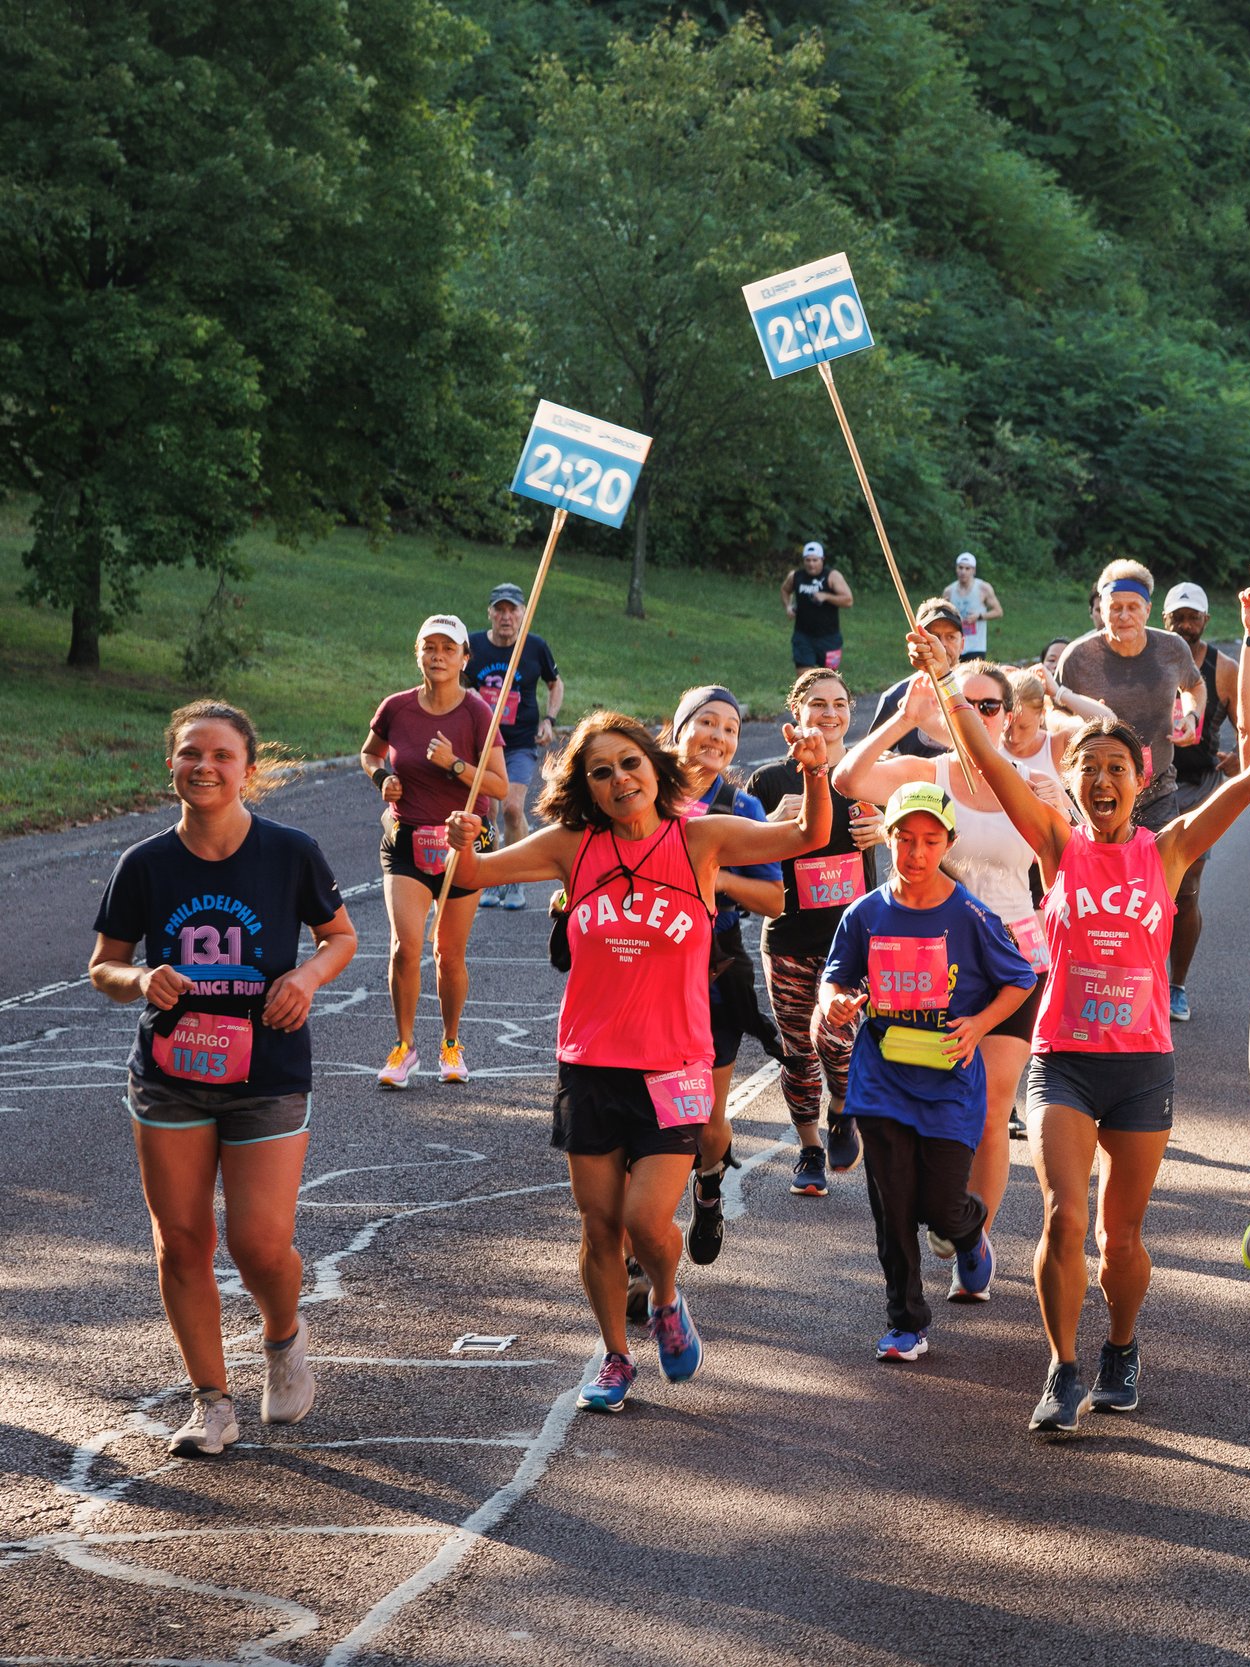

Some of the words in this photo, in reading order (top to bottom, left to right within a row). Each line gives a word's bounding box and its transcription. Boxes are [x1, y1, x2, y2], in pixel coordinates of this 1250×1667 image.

[767, 294, 864, 364] 2:20
[524, 443, 632, 515] 2:20
[819, 869, 843, 881] AMY
[809, 880, 854, 903] 1265
[164, 894, 263, 936] PHILADELPHIA
[577, 892, 694, 945] PACER
[605, 938, 650, 948] PHILADELPHIA
[1087, 929, 1130, 939] PHILADELPHIA
[1093, 939, 1122, 948] DISTANCE
[178, 924, 242, 966] 13.1
[611, 946, 642, 955] DISTANCE
[1101, 948, 1115, 956] RUN
[619, 955, 633, 963] RUN
[233, 981, 266, 996] RUN
[879, 970, 933, 993] 3158
[1084, 981, 1135, 999] ELAINE
[1080, 998, 1132, 1027] 408
[173, 1029, 230, 1049] MARGO
[172, 1047, 228, 1078] 1143
[678, 1078, 707, 1092] MEG
